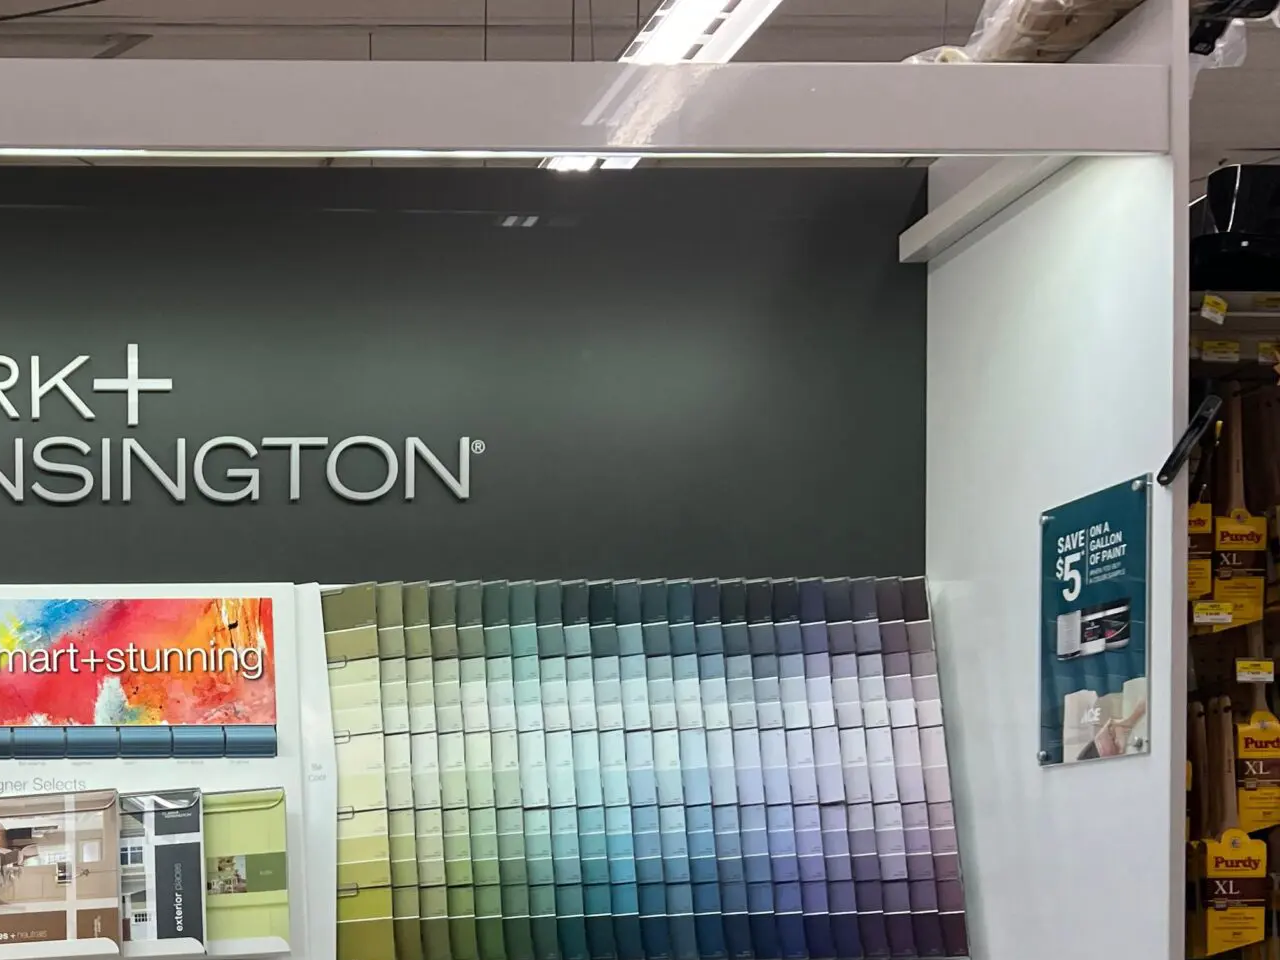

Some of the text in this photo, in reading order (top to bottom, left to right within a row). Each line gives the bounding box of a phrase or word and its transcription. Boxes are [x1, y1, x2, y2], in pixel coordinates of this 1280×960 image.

[1089, 521, 1111, 538] ON A
[1057, 529, 1086, 554] SAVE
[1089, 530, 1123, 551] GALLON
[1220, 530, 1263, 545] Purdy
[1089, 543, 1127, 565] OF PAINT
[1220, 552, 1242, 565] XL
[1244, 737, 1280, 750] Purd
[1244, 760, 1270, 775] XL
[33, 777, 86, 791] Selects
[1214, 855, 1260, 871] Purdy
[1213, 880, 1240, 895] XL
[173, 892, 184, 931] exterior
